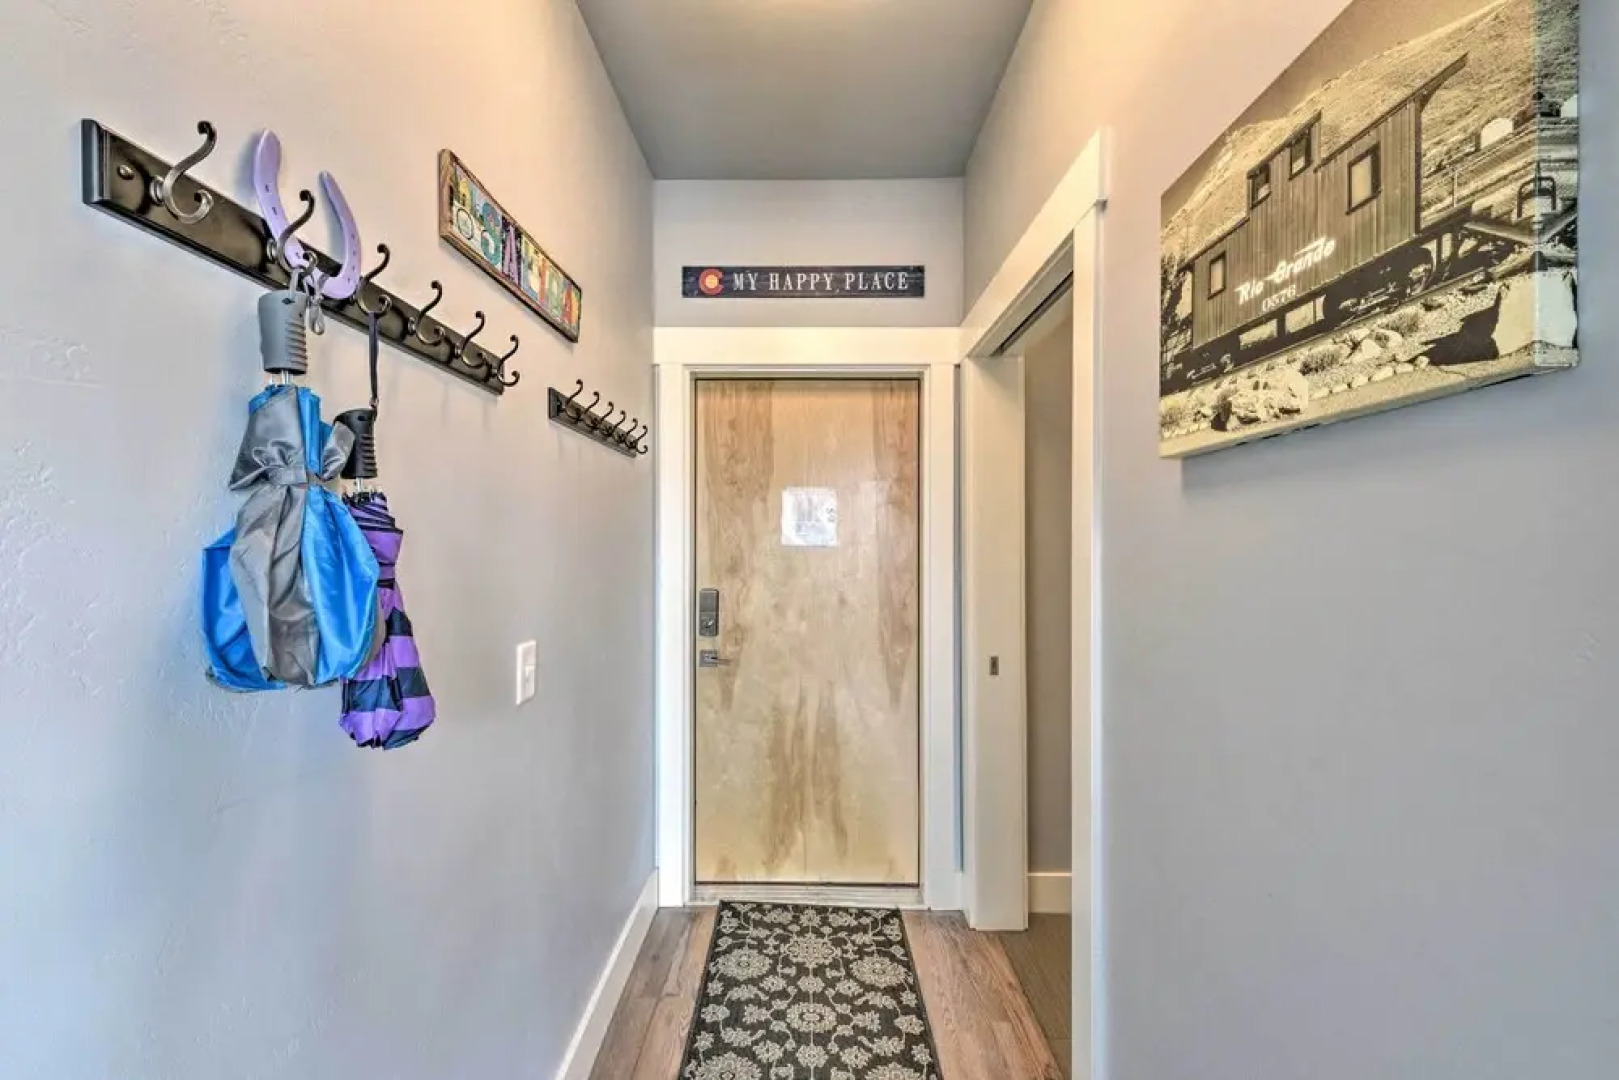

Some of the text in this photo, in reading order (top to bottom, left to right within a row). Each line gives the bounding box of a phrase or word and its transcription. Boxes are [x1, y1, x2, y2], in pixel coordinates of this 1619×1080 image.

[733, 272, 759, 291] MY
[768, 272, 834, 291] HAPPY
[844, 271, 909, 291] PLACE
[1235, 278, 1263, 305] Rio
